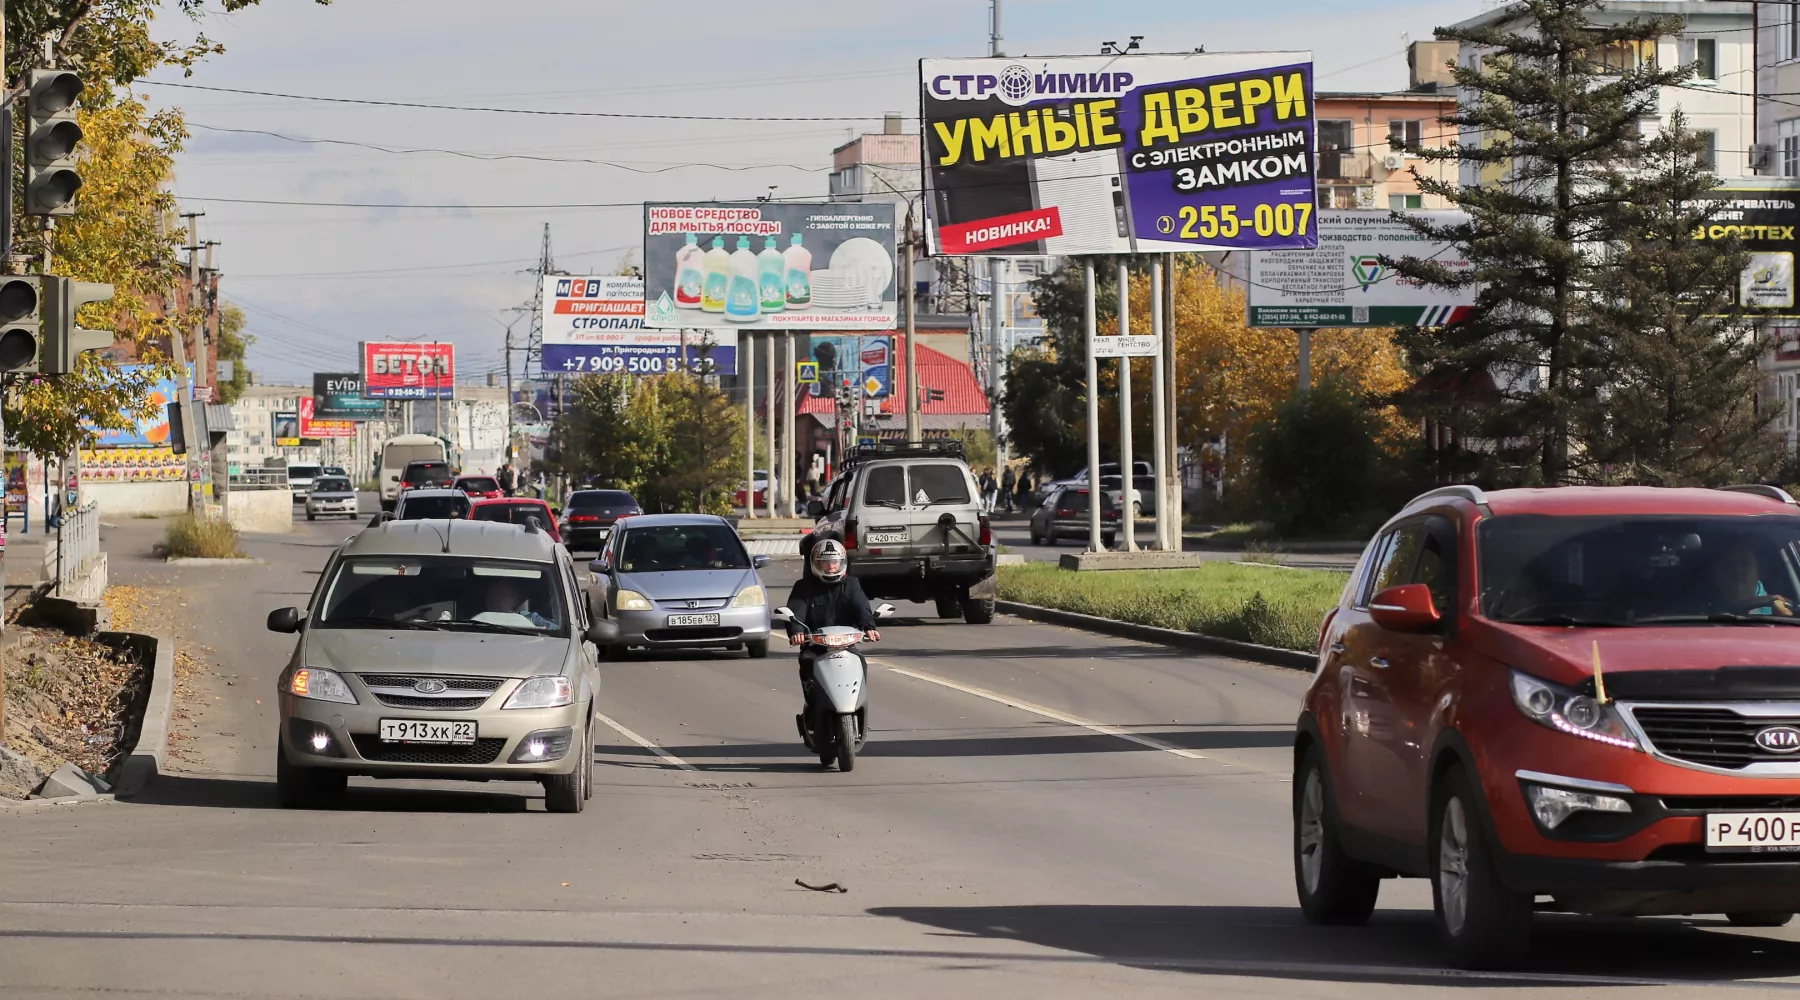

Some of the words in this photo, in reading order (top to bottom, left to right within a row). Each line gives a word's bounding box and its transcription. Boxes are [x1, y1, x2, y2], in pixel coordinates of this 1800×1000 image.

[933, 99, 1121, 166] УМНЫЕ
[1141, 73, 1306, 146] ДВЕРИ
[1131, 152, 1147, 168] С
[1149, 131, 1305, 166] ЭЛЕКТРОННЫМ
[1177, 154, 1307, 189] ЗАМКОМ
[1681, 199, 1795, 209] ВОДОАГРЕВАТЕЛЬ
[651, 209, 692, 219] НОВОЕ
[695, 209, 760, 220] СРЕДСТВО
[816, 222, 849, 230] ЗАБОТОЙ
[1180, 203, 1313, 239] 255-007
[1344, 216, 1396, 226] олеумный
[651, 222, 677, 233] ДЛЯ
[680, 222, 724, 232] МЫТЬЯ
[727, 222, 780, 233] ПОСУДЫ
[965, 217, 1051, 244] НОВИНКА!
[557, 283, 598, 294] МСВ
[571, 303, 645, 312] ПРИГЛАШАЕТ
[634, 334, 661, 343] график
[614, 346, 666, 355] Пригородная
[372, 354, 449, 375] БЕТОН
[563, 357, 586, 372] +7
[590, 357, 624, 373] 909
[628, 357, 661, 373] 500
[704, 614, 717, 622] 122
[387, 722, 450, 739] Т913ХК
[454, 723, 471, 736] 22
[1764, 732, 1800, 746] KIA
